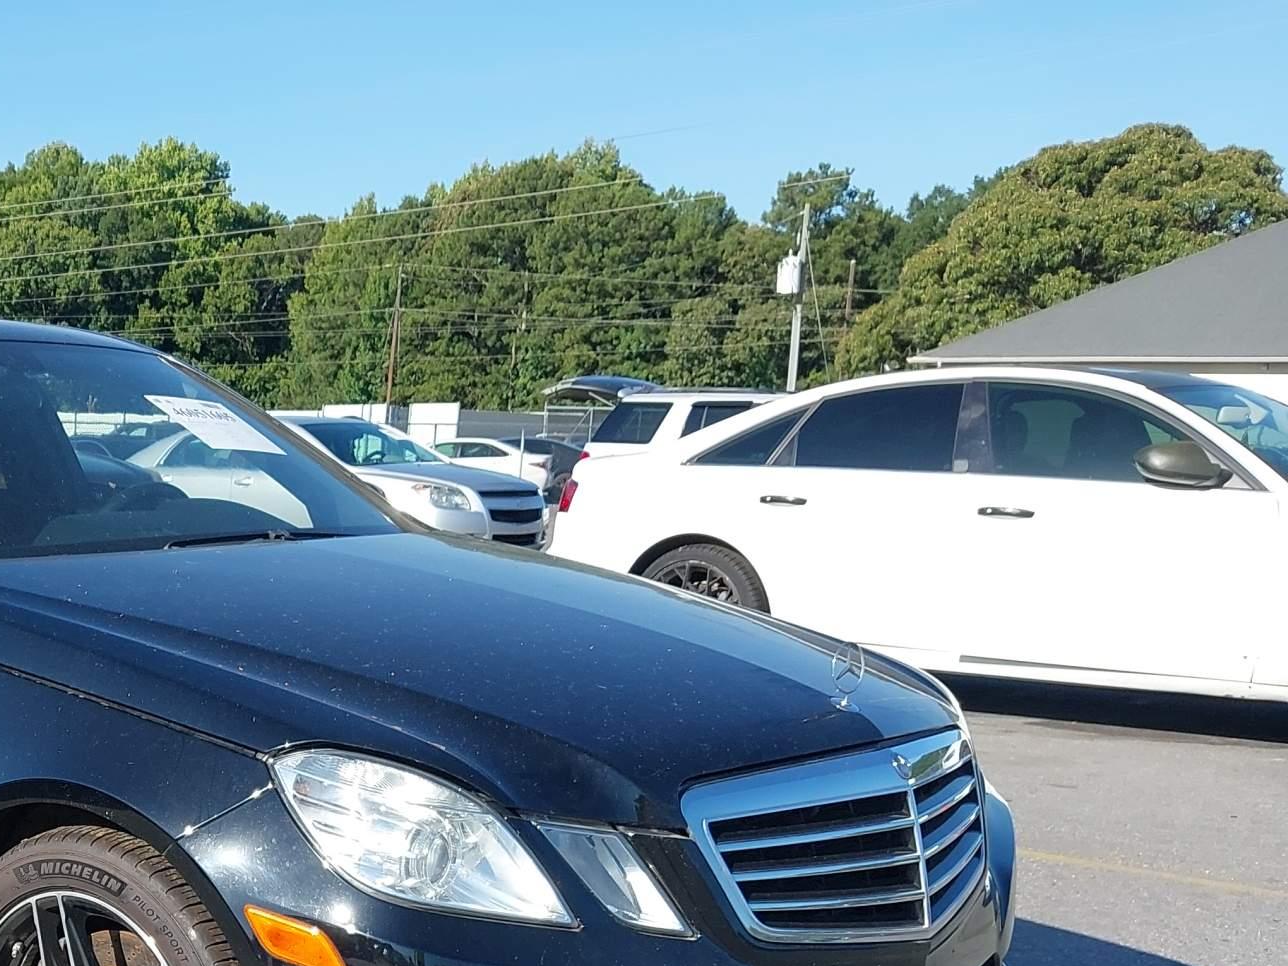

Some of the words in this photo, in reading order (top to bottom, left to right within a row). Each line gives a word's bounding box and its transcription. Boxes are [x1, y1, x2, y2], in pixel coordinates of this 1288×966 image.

[40, 861, 122, 893] MICHELIN
[132, 895, 161, 922] PILOT
[159, 925, 189, 963] SPORT
